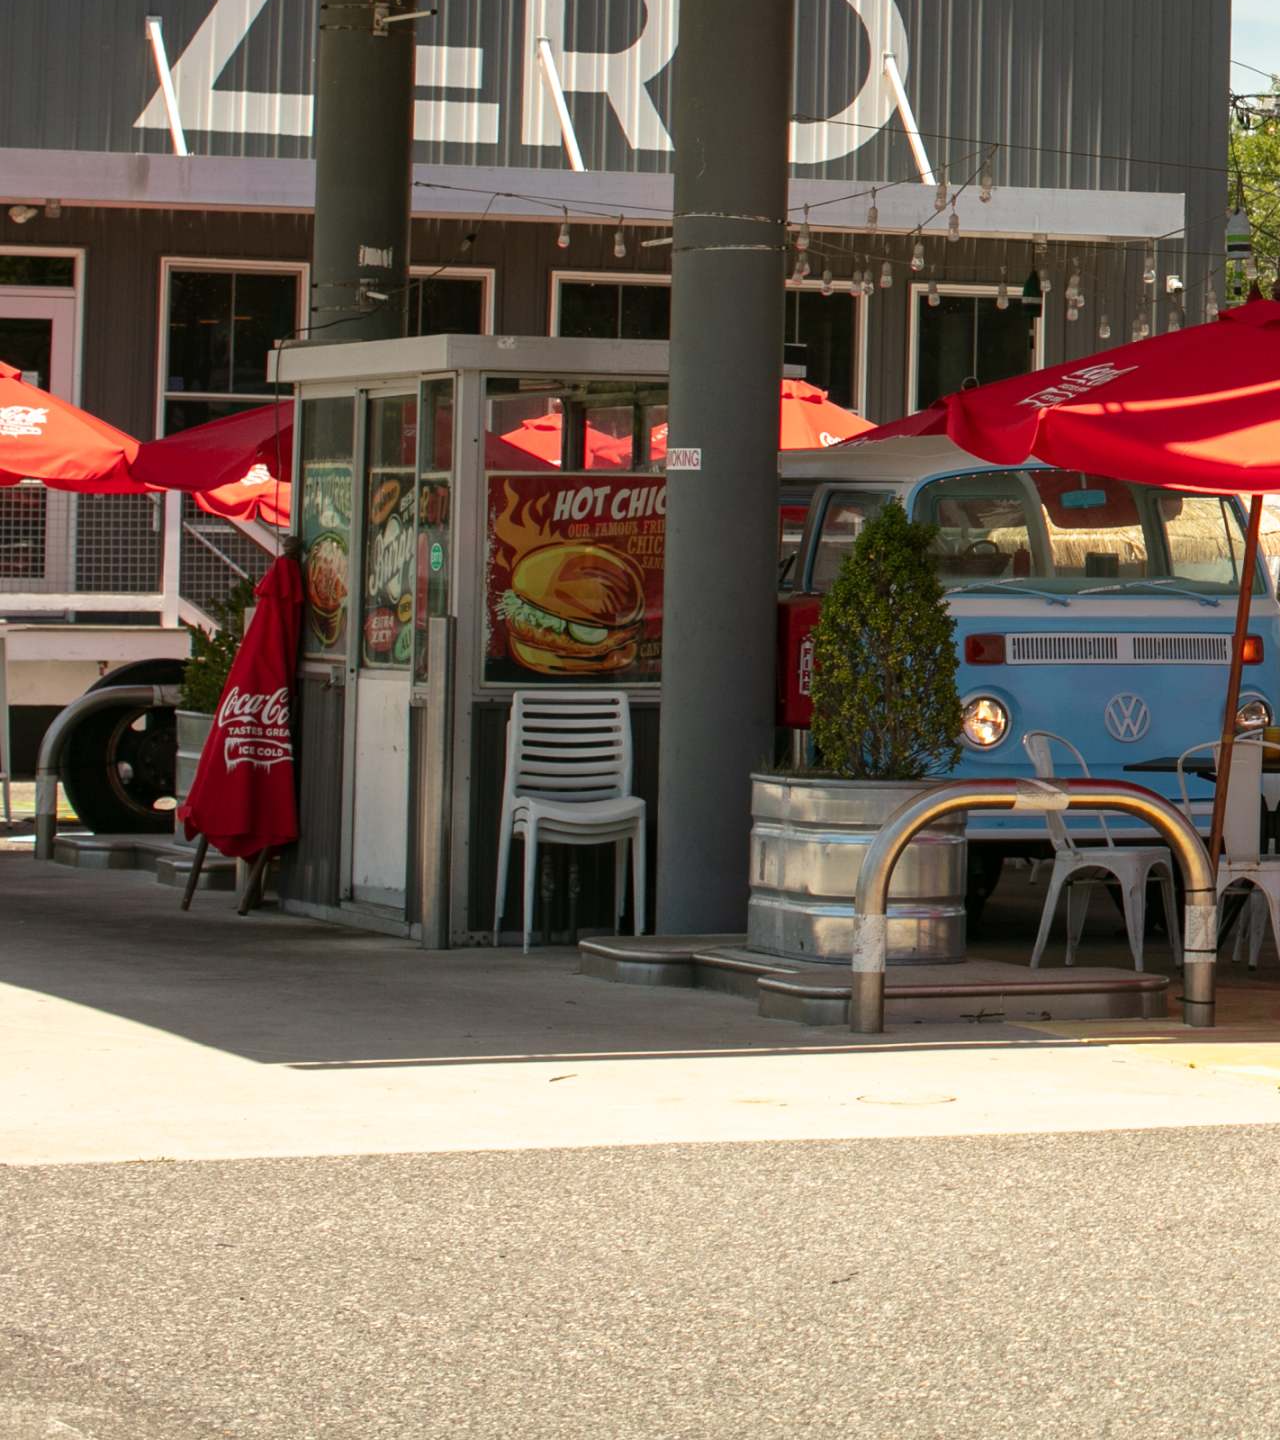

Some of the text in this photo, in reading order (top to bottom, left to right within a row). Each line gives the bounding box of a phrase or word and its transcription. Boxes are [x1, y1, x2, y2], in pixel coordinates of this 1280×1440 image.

[552, 486, 612, 522] HOT
[568, 523, 590, 538] OUR
[594, 521, 639, 536] FAMOUS
[627, 536, 665, 555] CHIC
[801, 647, 812, 691] FIRE
[228, 726, 263, 736] TASTES
[238, 746, 284, 758] ICE COLD
